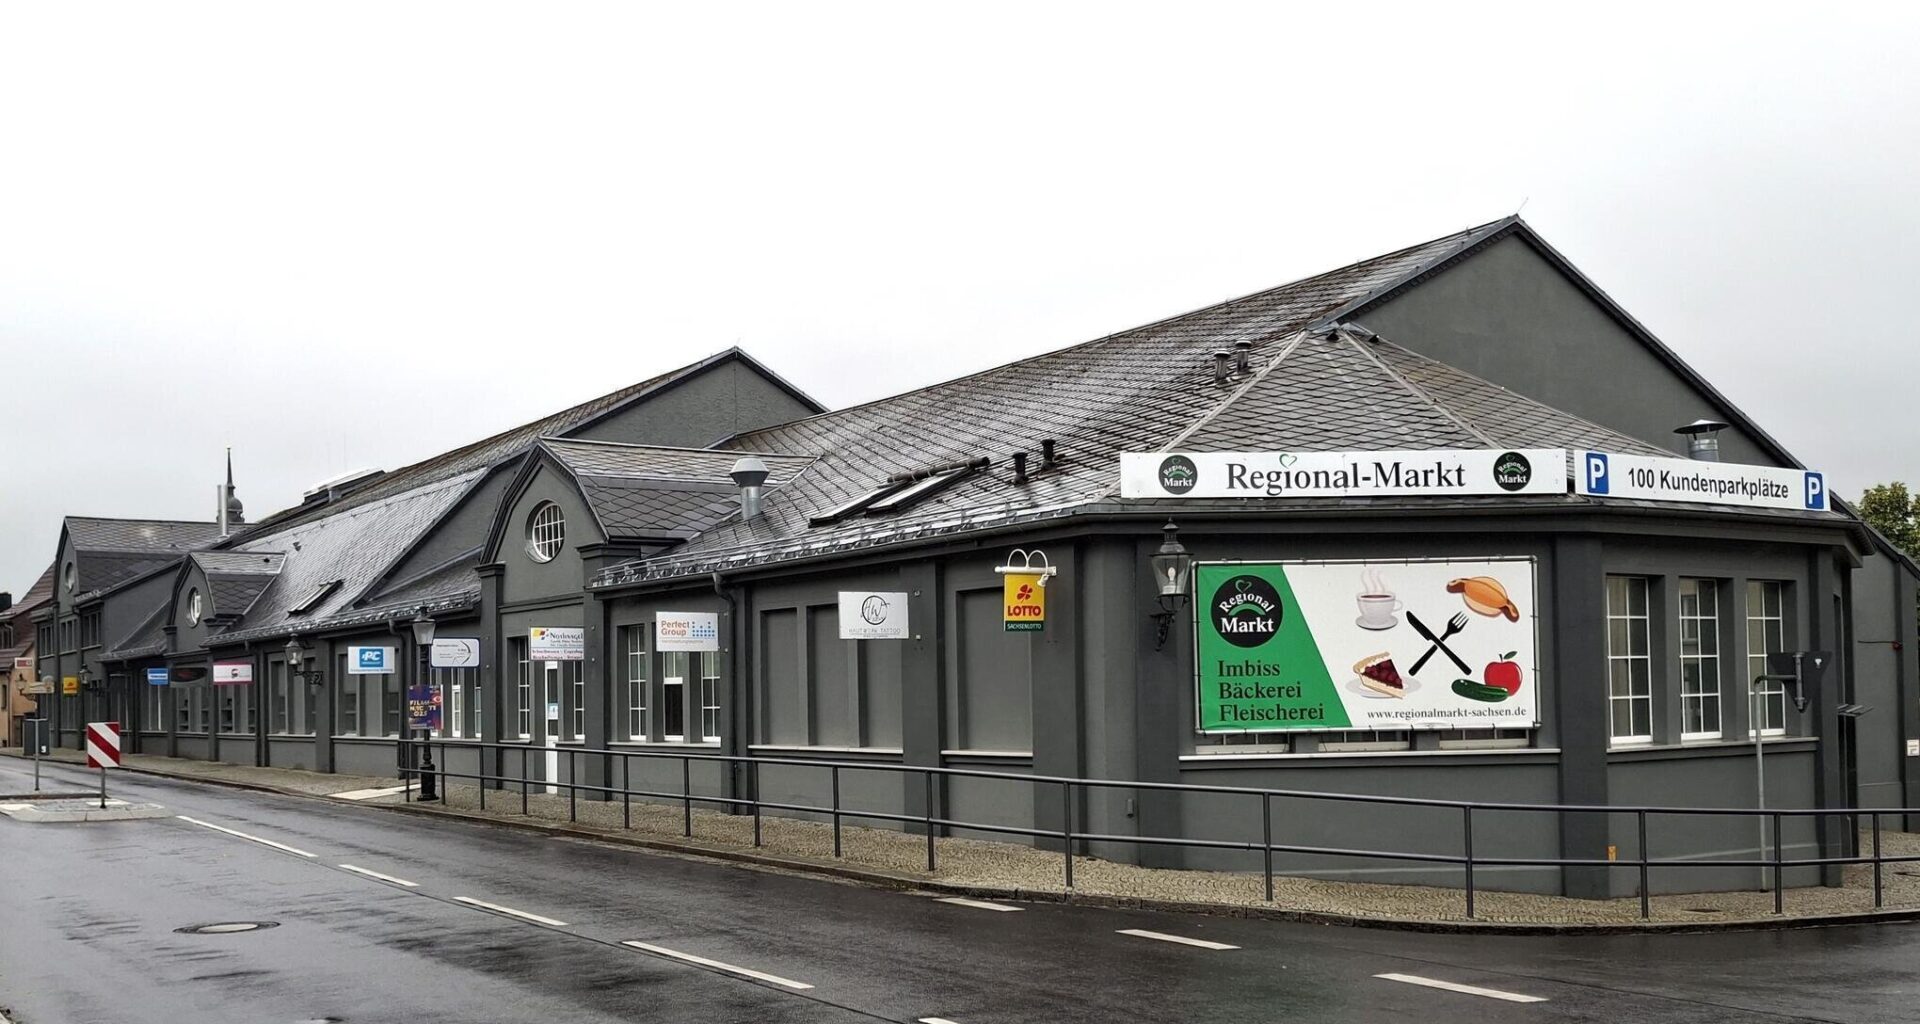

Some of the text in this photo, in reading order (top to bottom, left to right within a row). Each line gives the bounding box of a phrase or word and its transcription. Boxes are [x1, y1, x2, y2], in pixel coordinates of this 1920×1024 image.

[1163, 465, 1193, 475] Regional
[1498, 461, 1527, 472] Regional
[1164, 477, 1192, 487] Markt
[1226, 462, 1466, 496] Regional-Markt
[1499, 474, 1527, 483] Markt
[1589, 457, 1821, 505] P 100 Kundenparkplätze P
[1219, 592, 1275, 613] Regional
[1007, 605, 1041, 617] LOTTO
[661, 620, 689, 628] Perfect
[1220, 617, 1274, 633] Markt
[661, 628, 687, 637] Group
[1218, 660, 1280, 677] Imbiss
[1219, 682, 1302, 699] Bäckerei
[1219, 703, 1324, 721] Fleischerei
[1367, 706, 1527, 720] www.regionalmarkt-sachsen.de
